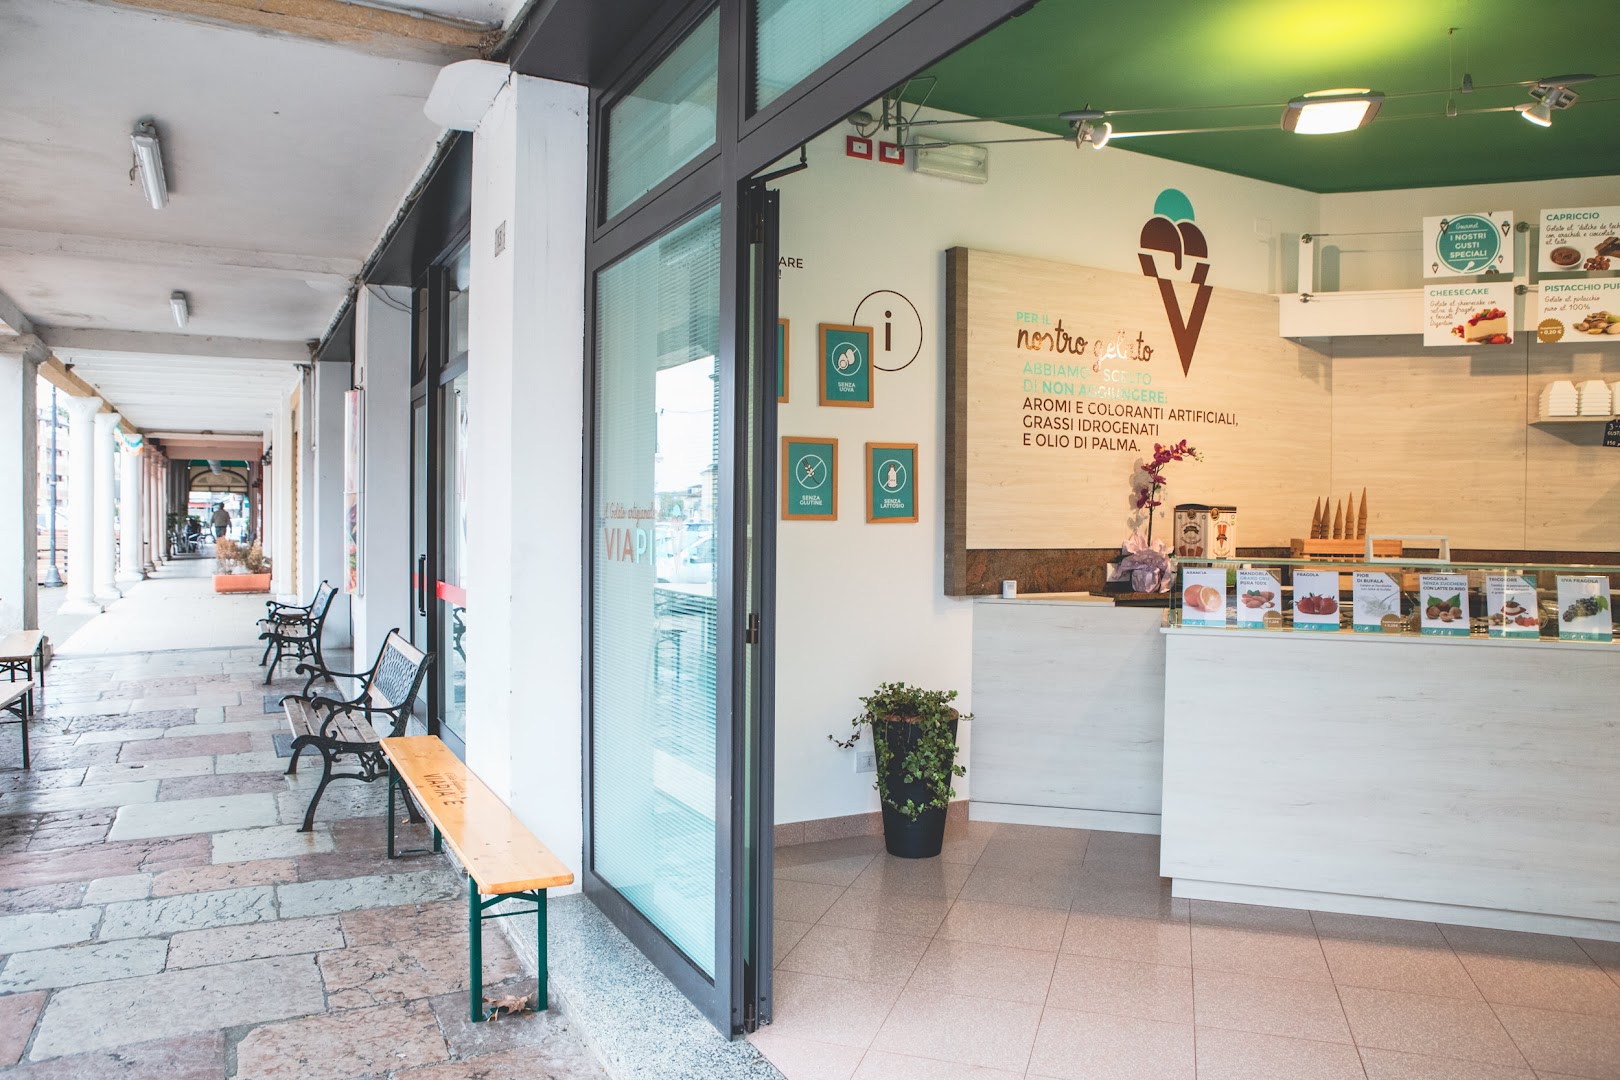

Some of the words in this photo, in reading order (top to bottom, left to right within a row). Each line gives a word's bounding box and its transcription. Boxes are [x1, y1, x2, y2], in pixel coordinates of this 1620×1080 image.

[1546, 212, 1600, 221] CAPRICCIO
[1454, 232, 1487, 241] NOSTRI
[1449, 250, 1487, 258] SPECIALI
[1430, 288, 1489, 297] CHEESECAKE
[1545, 284, 1602, 292] PISTACCHIO
[1573, 294, 1600, 303] pistacchio
[1569, 303, 1590, 311] 100%
[1016, 311, 1039, 324] PER
[1042, 314, 1052, 325] IL
[1016, 319, 1089, 356] nostro
[1092, 329, 1154, 373] gelato
[1023, 361, 1090, 380] ABBIAMO
[1103, 368, 1152, 385] SCELTO
[1023, 379, 1037, 393] DI
[1042, 380, 1074, 396] NON
[1078, 384, 1168, 404] AGGIUNGERE:
[1022, 397, 1071, 413] AROMI
[1076, 401, 1083, 414] E
[1087, 402, 1163, 420] COLORANTI
[1168, 408, 1239, 427] ARTIFICIALI,
[1022, 414, 1074, 431] GRASSI
[1078, 418, 1159, 436] IDROGENATI
[1023, 433, 1031, 446] E
[1035, 433, 1070, 448] OLIO
[1074, 436, 1087, 449] DI
[1092, 437, 1141, 452] PALMA.
